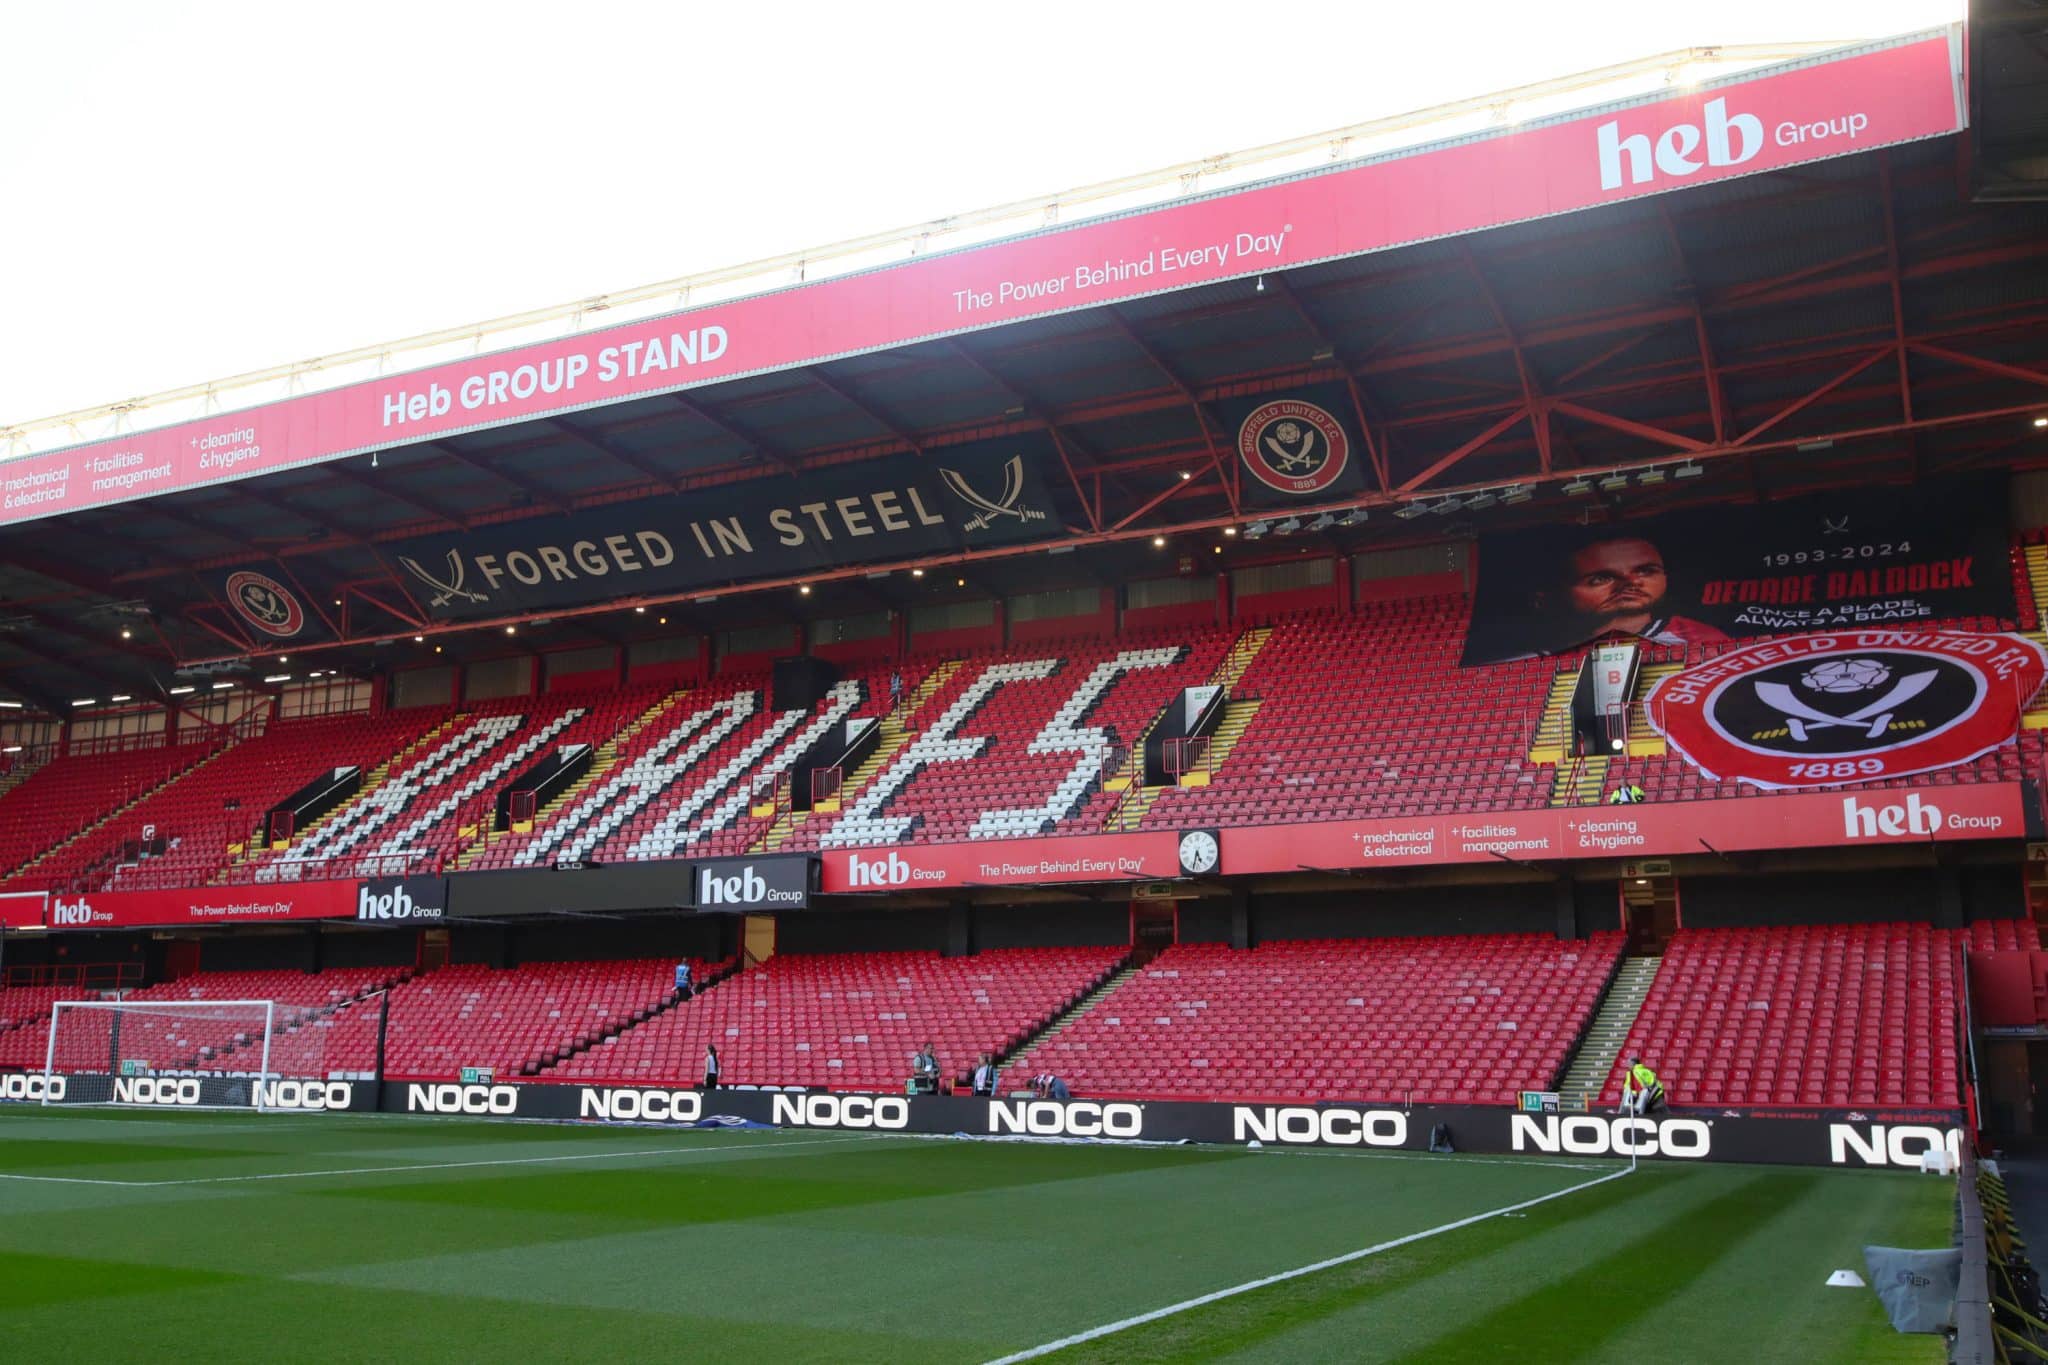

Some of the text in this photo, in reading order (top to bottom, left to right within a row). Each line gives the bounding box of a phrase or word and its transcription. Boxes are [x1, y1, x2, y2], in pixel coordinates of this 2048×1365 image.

[1597, 96, 1868, 191] heb Group
[953, 231, 1284, 313] The Power Behind Every Day
[383, 326, 728, 427] Heb GROUP STAND
[1282, 404, 1325, 423] UNITED
[200, 427, 255, 451] cleaning
[93, 450, 144, 474] facilities
[5, 464, 70, 491] mechanical
[93, 463, 172, 492] management
[475, 487, 944, 589] FORGED IN STEEL
[1763, 540, 1911, 567] 1993-2024
[1827, 557, 1974, 600] BALDOCK
[1746, 605, 1811, 618] ONCE
[1816, 606, 1833, 617] A
[1831, 614, 1849, 624] A
[1855, 606, 1932, 622] BLADE
[1608, 670, 1621, 685] B
[1664, 637, 1837, 706] SHEFFIELD
[1857, 632, 1997, 654] UNITED
[1788, 758, 1885, 780] 1889
[1578, 819, 1637, 834] cleaning
[1843, 793, 2001, 838] heb Group
[1363, 827, 1434, 844] mechanical
[1461, 824, 1517, 839] facilities
[1463, 836, 1549, 853] management
[849, 852, 946, 886] heb Group
[979, 857, 1142, 876] The Power Behind Every Day
[701, 866, 802, 904] heb Group
[53, 898, 114, 925] heb Group
[190, 902, 290, 916] The Power Behind Every Day
[359, 885, 442, 920] heb Group
[113, 1077, 200, 1105] NOCO
[252, 1080, 351, 1110] NOCO
[407, 1083, 517, 1114] NOCO
[580, 1088, 701, 1122] NOCO
[773, 1094, 909, 1129] NOCO
[988, 1100, 1142, 1137] NOCO
[1233, 1106, 1408, 1147] NOCO
[1511, 1114, 1711, 1158] NOCO
[1829, 1124, 1960, 1168] NO
